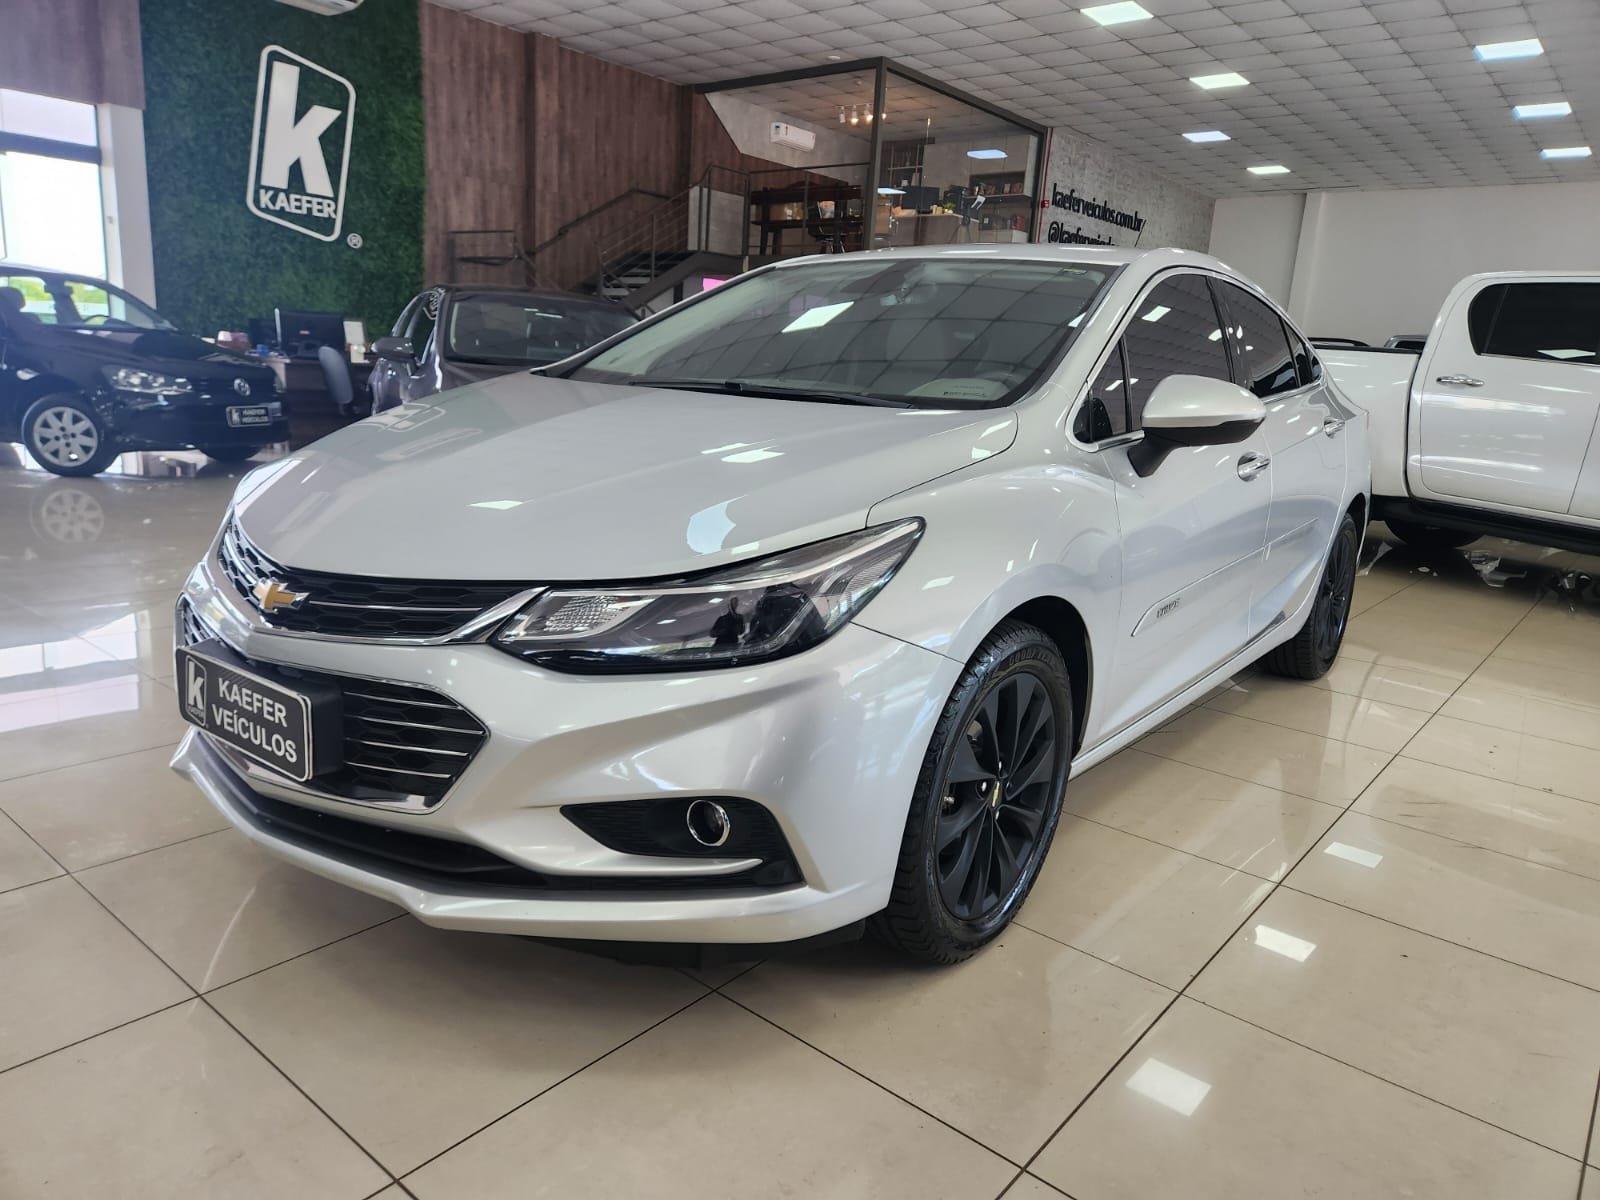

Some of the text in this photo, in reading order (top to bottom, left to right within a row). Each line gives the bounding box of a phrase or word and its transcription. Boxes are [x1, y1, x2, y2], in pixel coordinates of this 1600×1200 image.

[258, 188, 337, 219] KAEFER
[218, 677, 288, 728] KAEFER
[211, 703, 297, 763] VEÍCULOS
